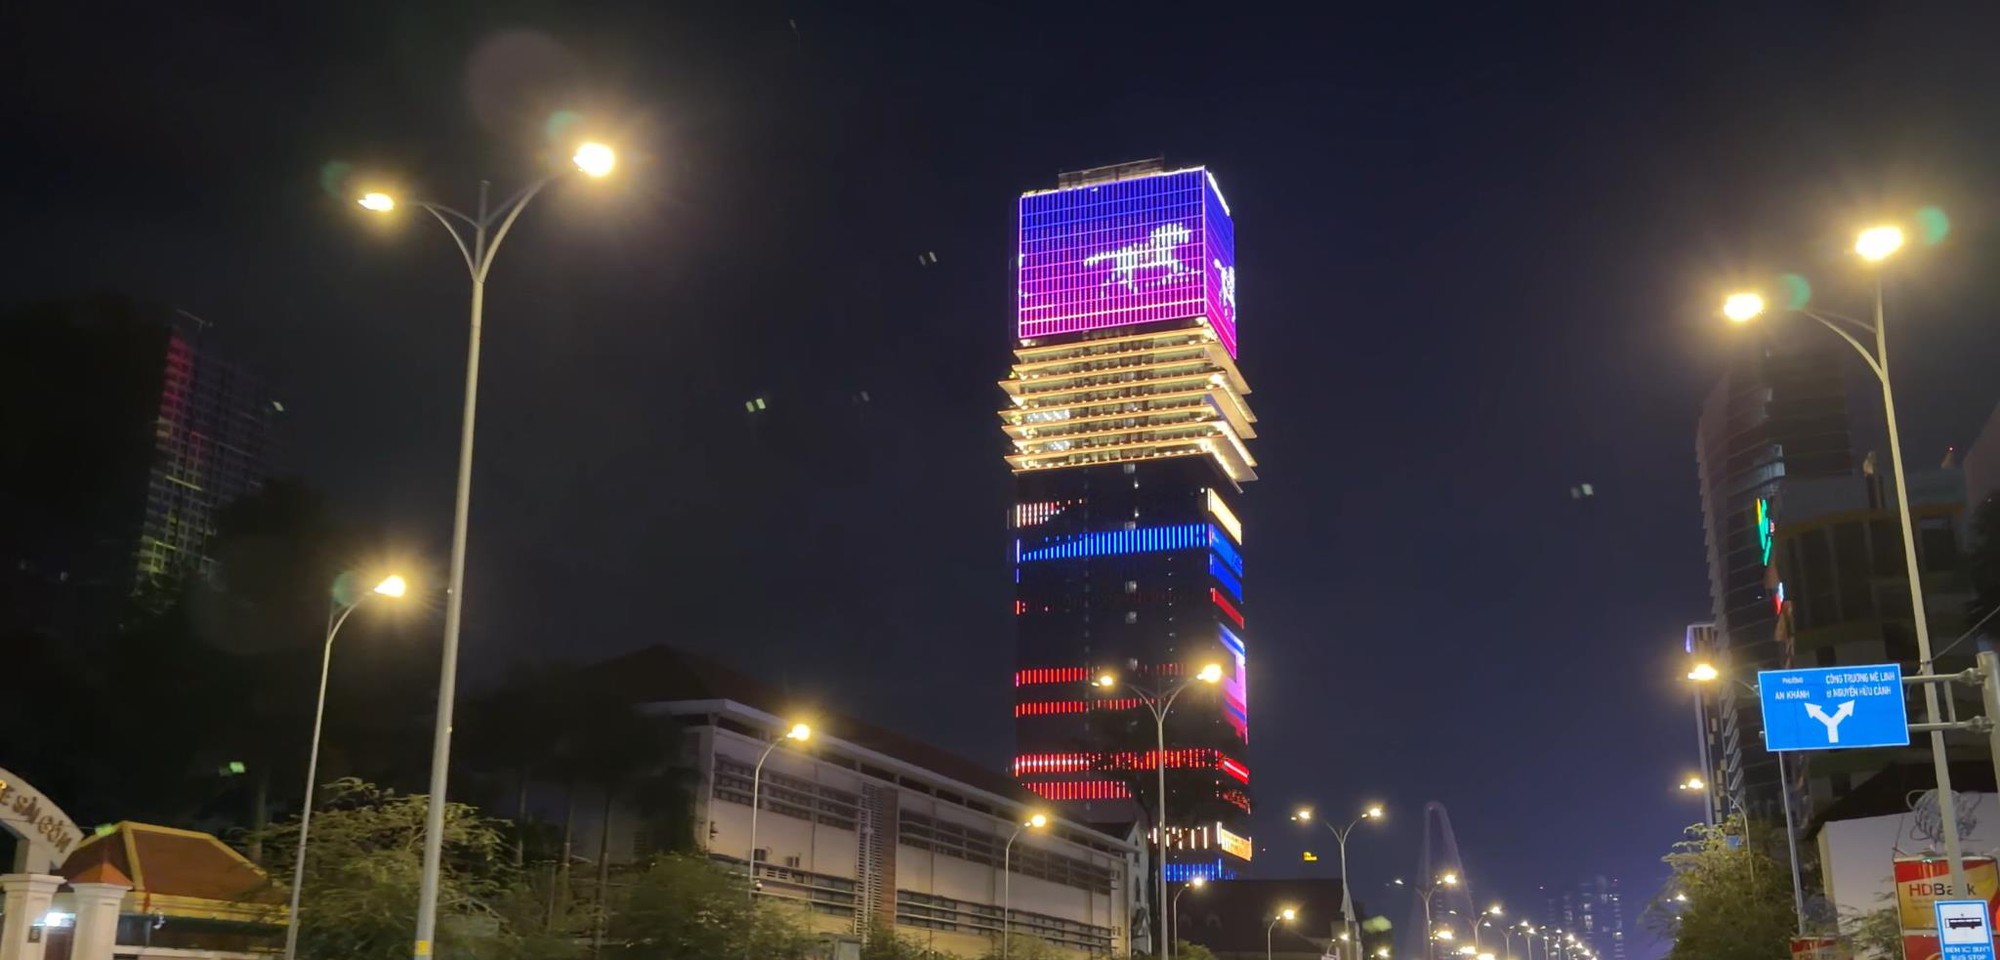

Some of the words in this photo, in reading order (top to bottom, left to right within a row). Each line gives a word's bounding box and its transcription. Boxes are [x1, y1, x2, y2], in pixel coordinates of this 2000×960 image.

[1880, 671, 1895, 682] LINH
[1775, 691, 1785, 700] AN
[1909, 883, 1976, 897] HDBak
